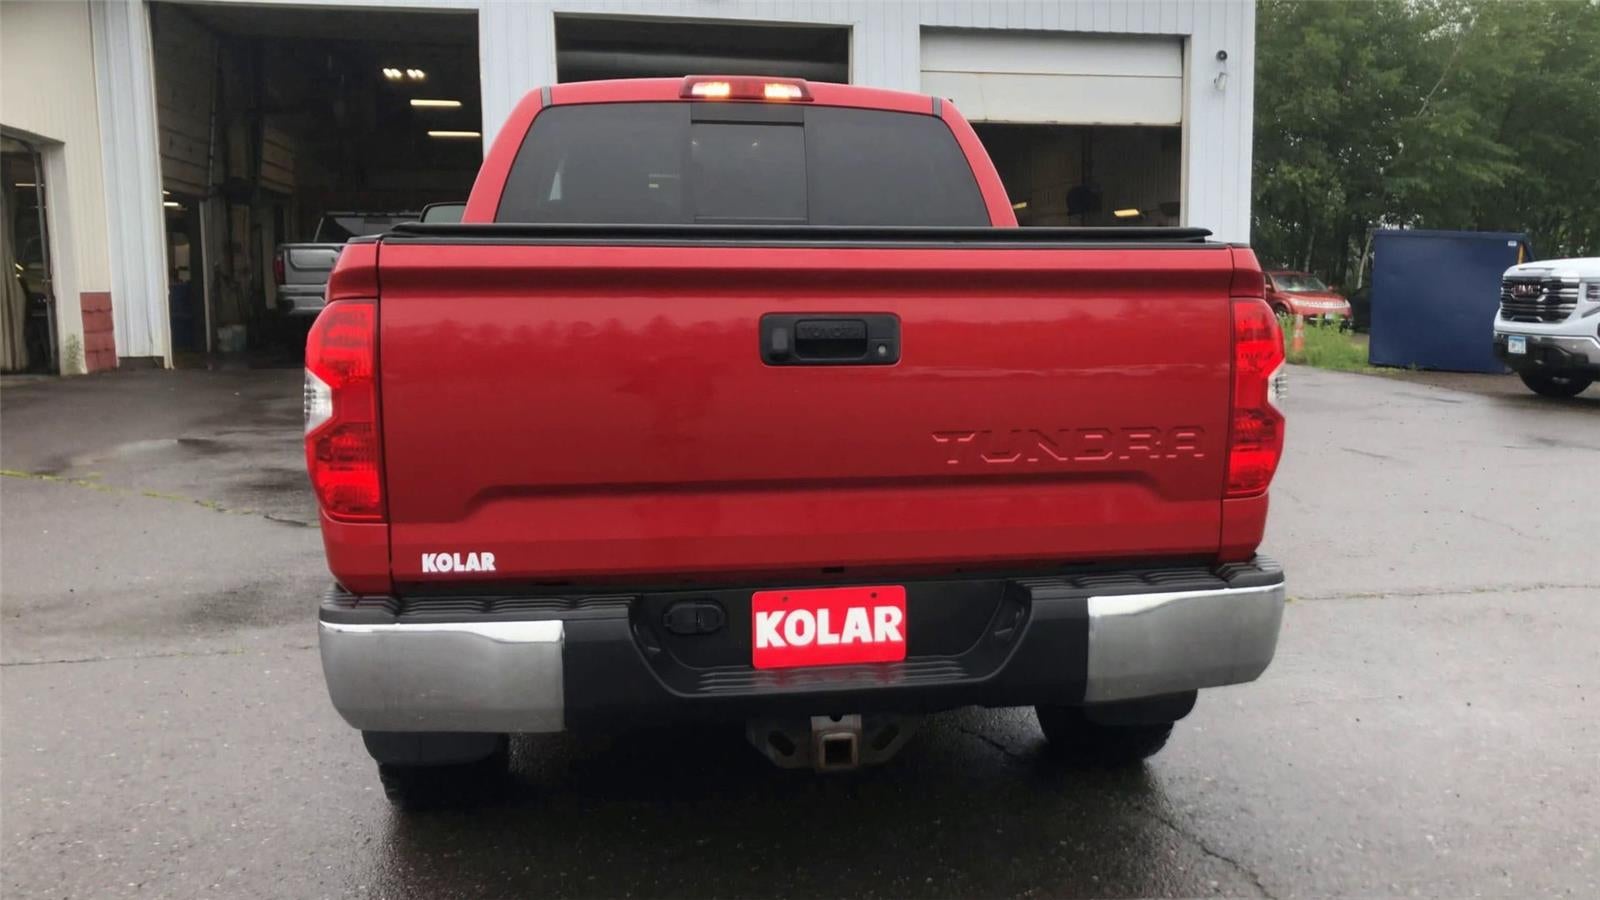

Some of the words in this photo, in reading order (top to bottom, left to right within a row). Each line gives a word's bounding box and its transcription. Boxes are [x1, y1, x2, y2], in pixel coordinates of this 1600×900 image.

[932, 426, 1205, 464] TUNDRA
[421, 552, 496, 573] KOLAR
[755, 605, 904, 649] KOLAR
